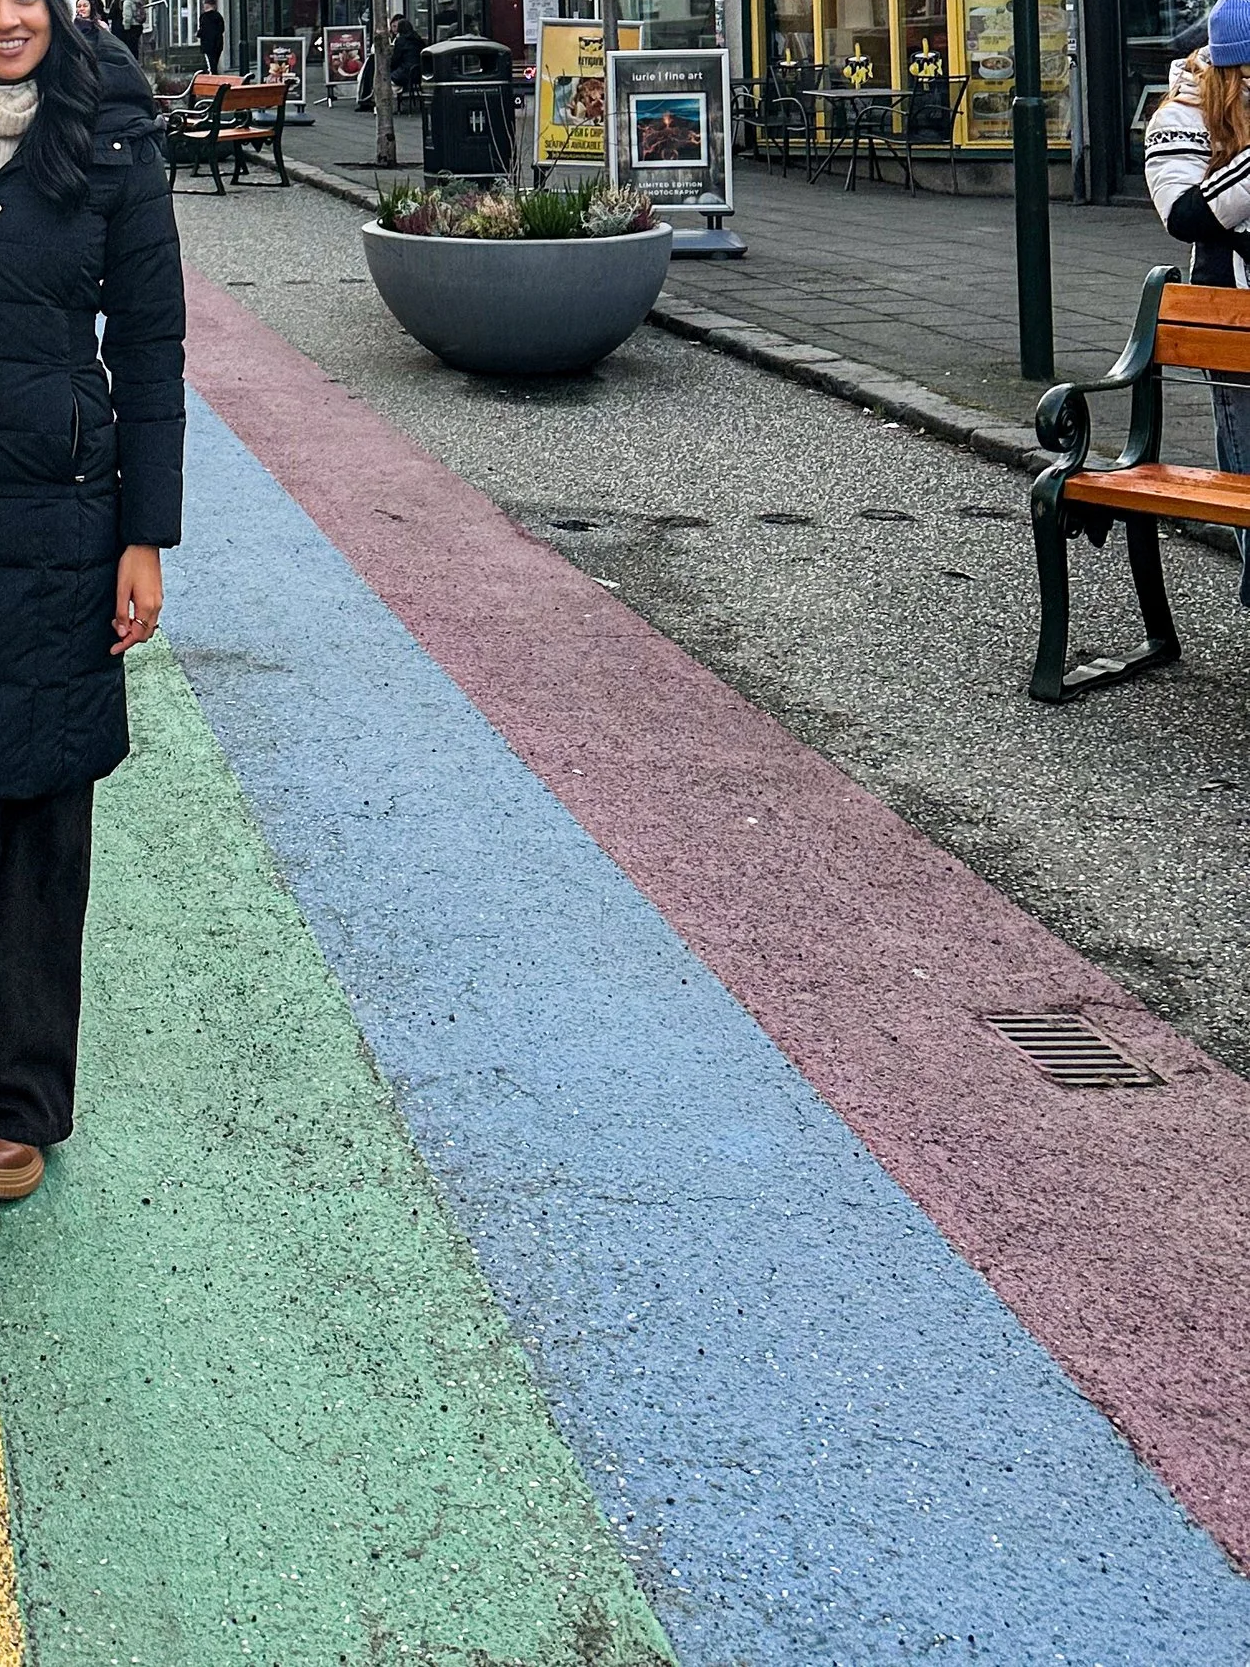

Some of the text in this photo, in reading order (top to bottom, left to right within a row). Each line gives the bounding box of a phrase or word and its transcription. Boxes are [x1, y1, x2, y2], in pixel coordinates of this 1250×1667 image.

[632, 73, 656, 81] iurie
[665, 72, 686, 81] fine
[688, 72, 703, 80] art
[590, 127, 604, 137] CHIP
[571, 141, 601, 150] AVAILABLE
